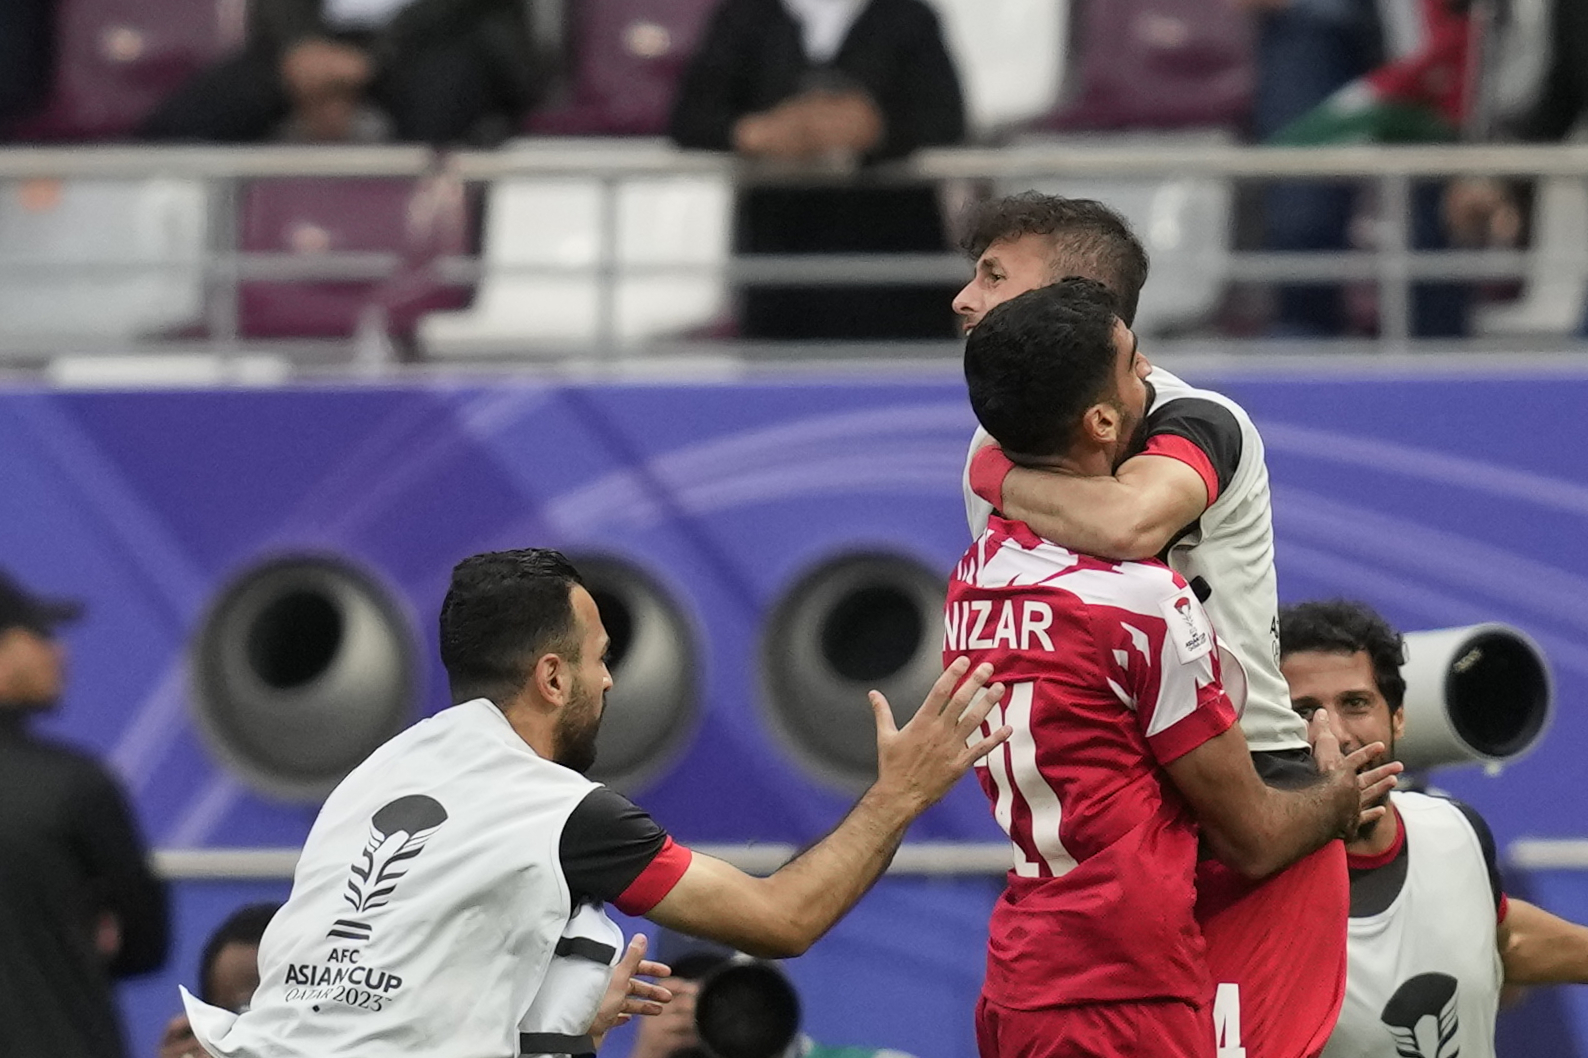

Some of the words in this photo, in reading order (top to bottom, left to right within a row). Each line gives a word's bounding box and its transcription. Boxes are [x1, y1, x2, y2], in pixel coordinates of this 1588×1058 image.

[942, 600, 1055, 652] NIZAR
[327, 947, 360, 964] AFC
[285, 963, 350, 986] ASIAN
[348, 966, 403, 993] CUP
